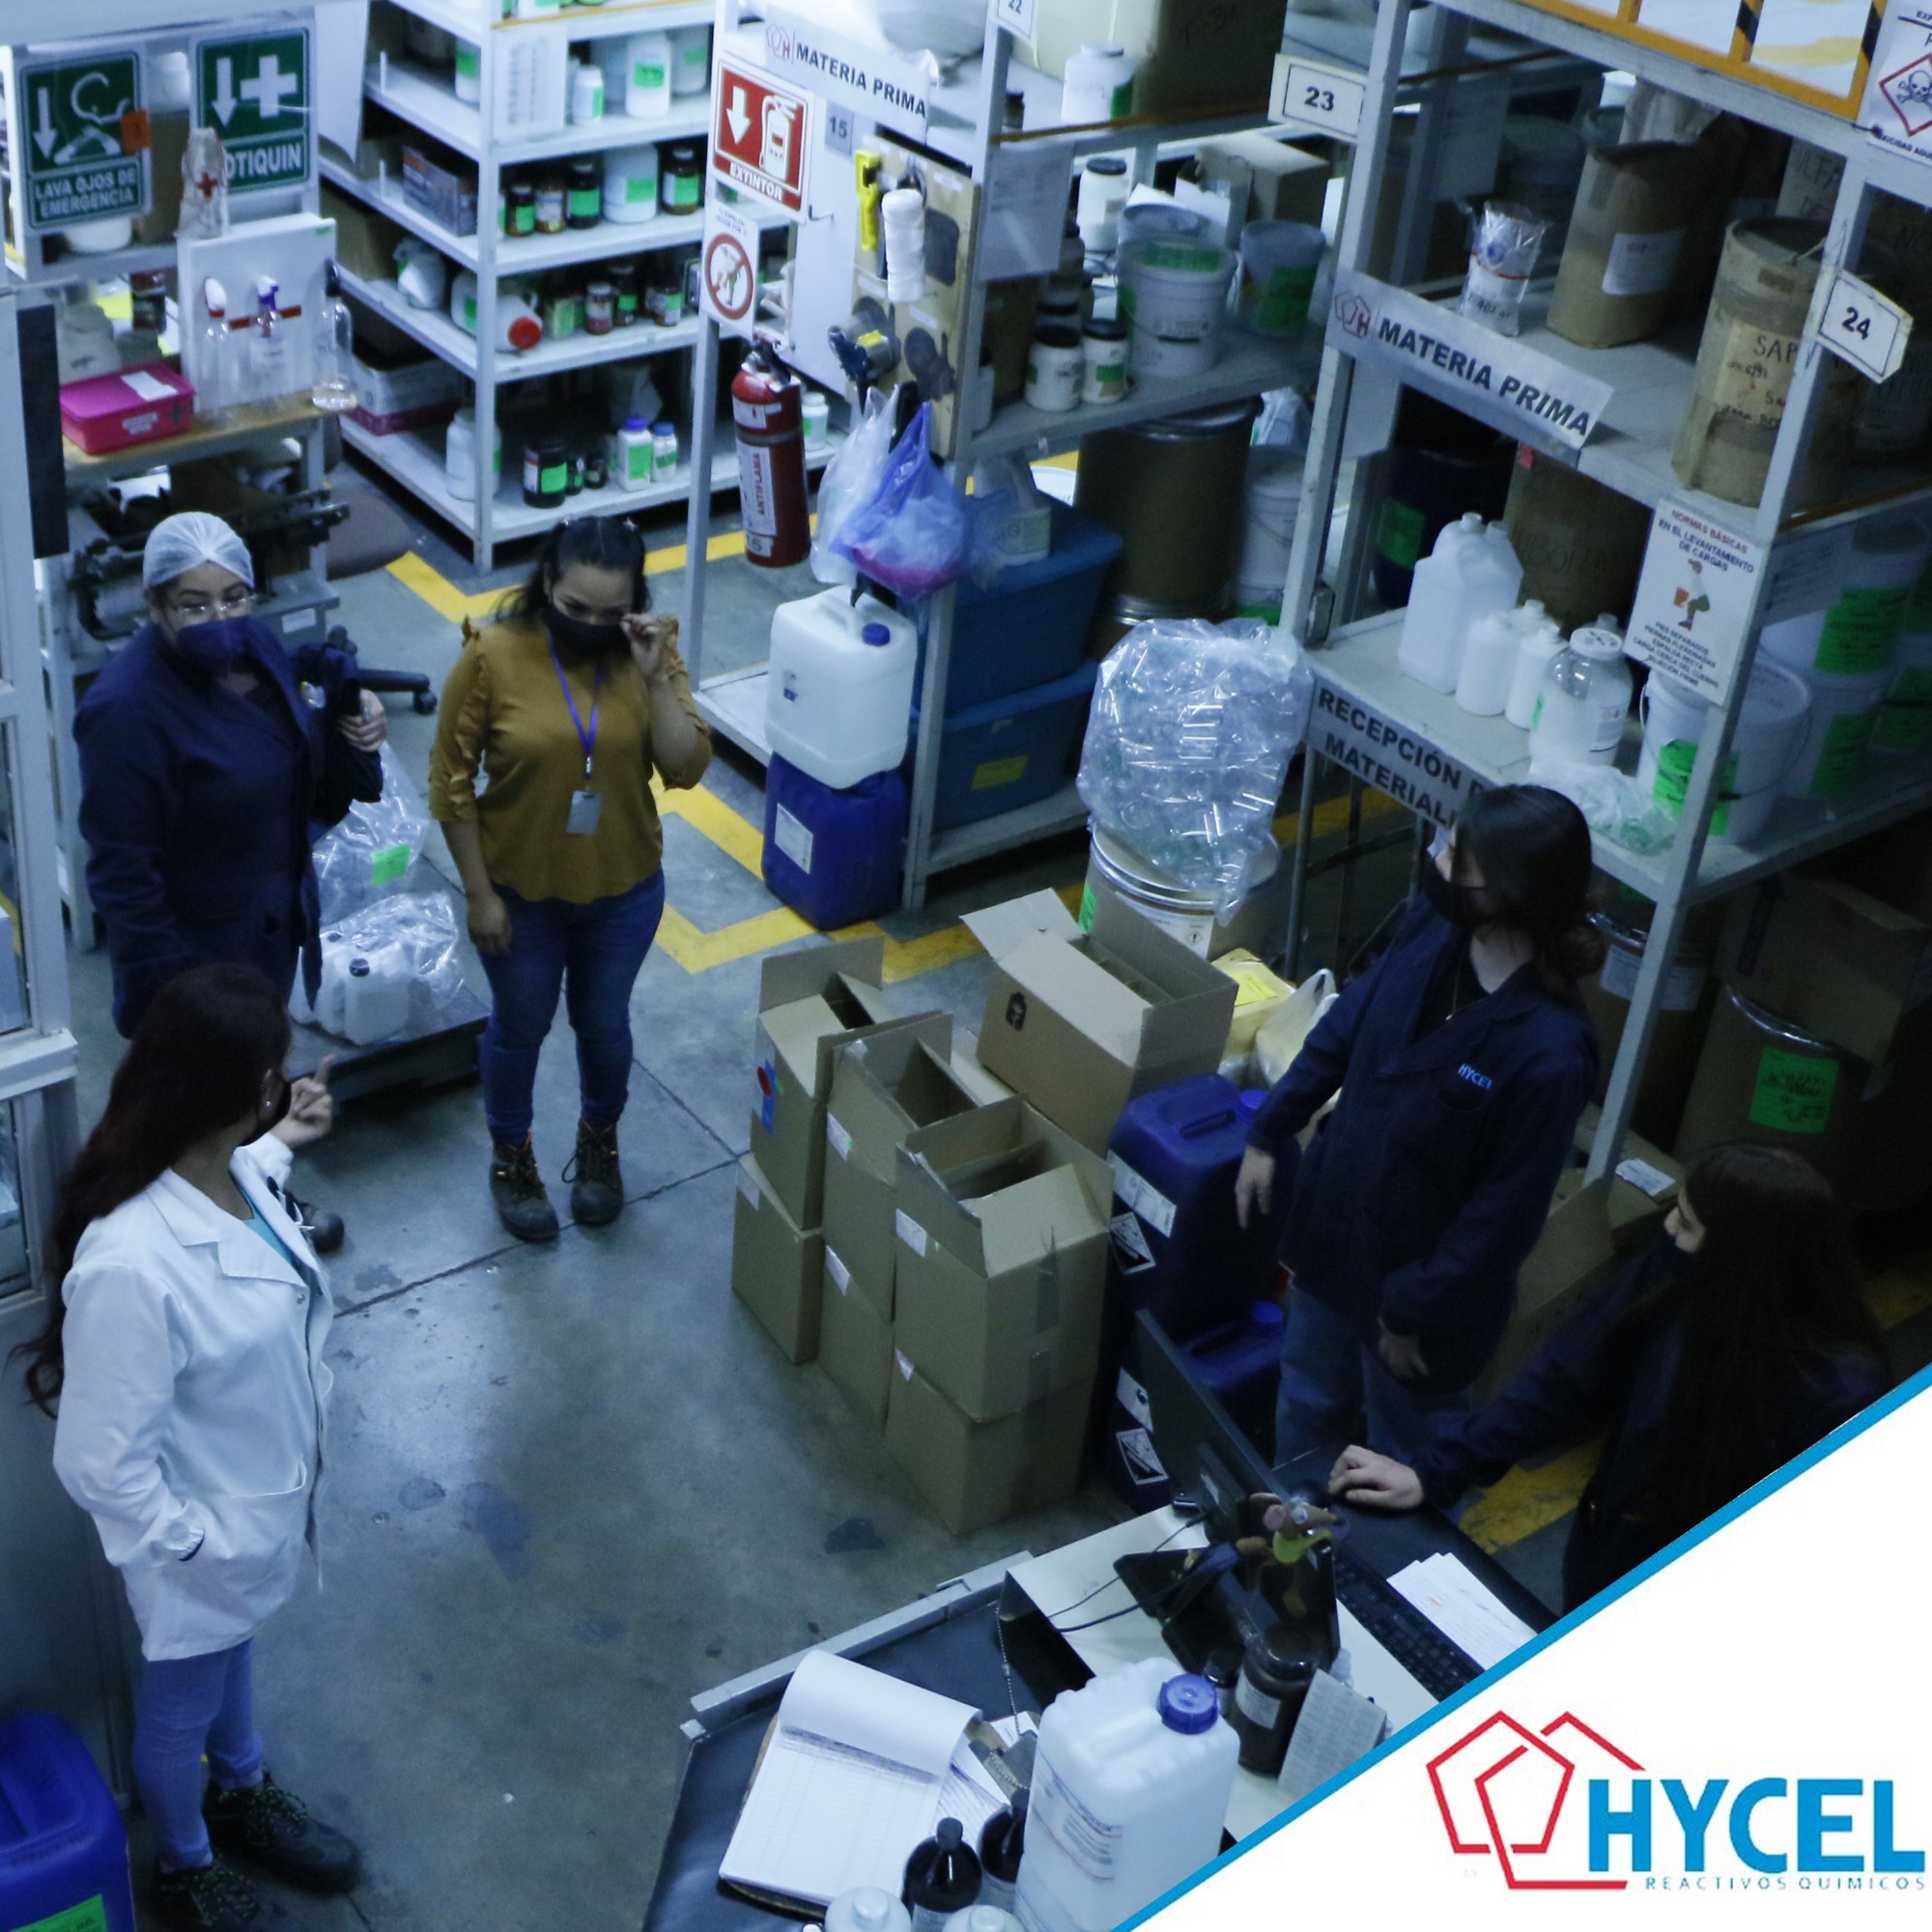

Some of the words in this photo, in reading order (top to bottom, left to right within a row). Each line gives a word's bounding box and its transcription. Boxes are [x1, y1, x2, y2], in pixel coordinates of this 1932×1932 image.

[796, 43, 867, 92] MATERIA
[872, 79, 927, 119] PRIMA
[1303, 87, 1336, 112] 23
[829, 115, 849, 139] 15
[225, 142, 301, 181] OTIQUIN
[35, 176, 72, 200] LAVA
[75, 170, 115, 193] OJOS
[117, 168, 136, 186] DE
[729, 161, 783, 202] EXTINTOR
[40, 186, 134, 215] EMERGENCIA
[1840, 306, 1872, 340] 24
[1378, 317, 1492, 391] MATERIA
[1498, 375, 1594, 438] PRIMA
[1672, 509, 1708, 534] NORMAS
[1658, 519, 1671, 532] EN
[1672, 526, 1685, 538] EL
[1684, 529, 1755, 574] LEVANTAMIENTO
[1678, 541, 1692, 555] DE
[1692, 547, 1729, 572] CARGAS
[1318, 687, 1462, 790] RECEPCIÓN
